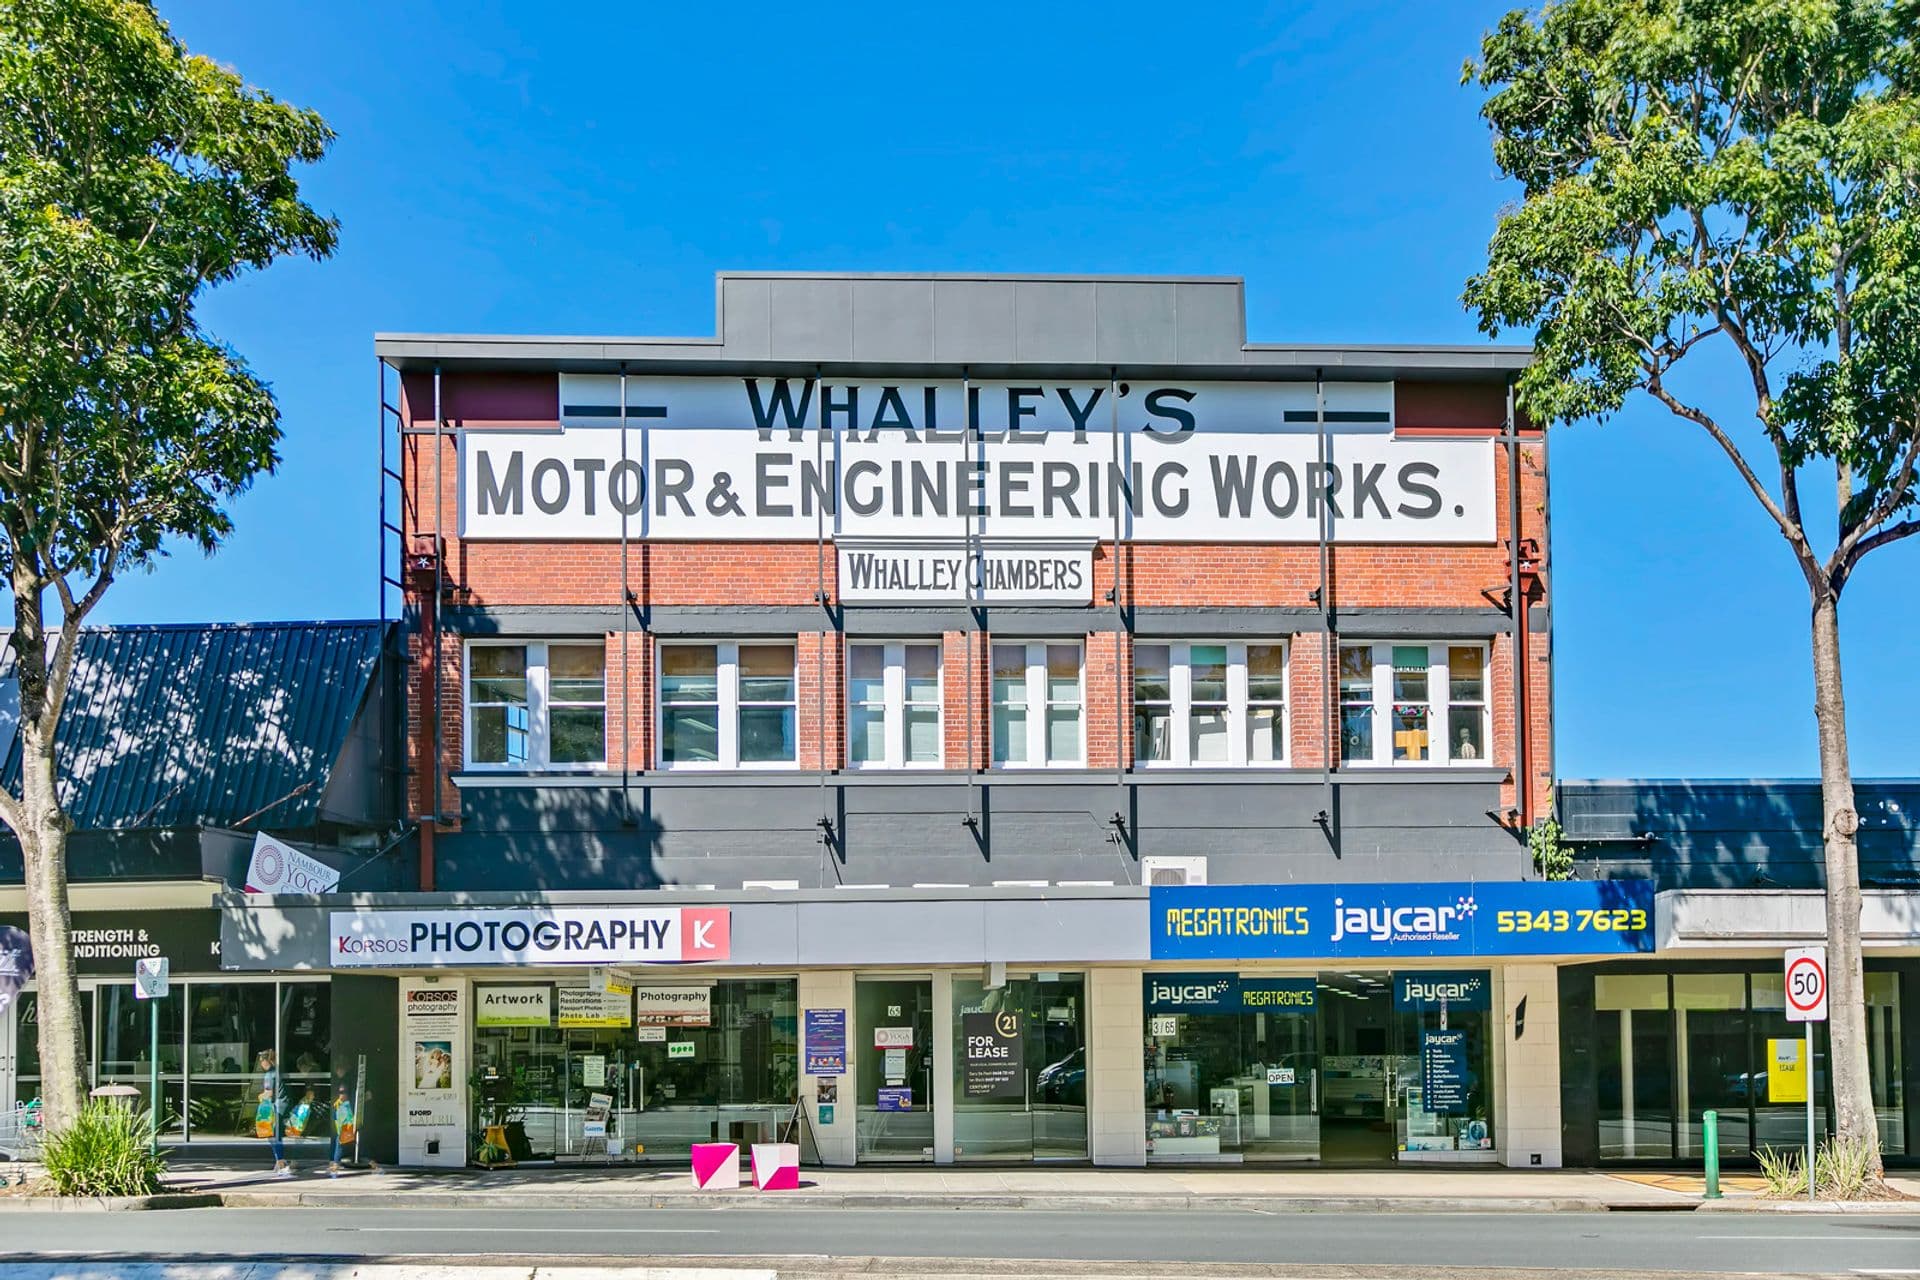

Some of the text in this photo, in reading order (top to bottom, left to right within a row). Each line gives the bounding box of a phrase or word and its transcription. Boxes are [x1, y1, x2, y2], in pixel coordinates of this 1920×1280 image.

[742, 378, 1198, 444] WHALLEY'S
[476, 450, 1465, 520] MOTOR & ENGINEERING WORKS.
[847, 553, 1083, 591] WHALLEY CHAMBERS
[287, 851, 333, 881] NAMBOUR
[1166, 897, 1648, 943] MEGATRONICS jaycar 5343 7623
[71, 929, 149, 944] TRENGTH &
[338, 919, 672, 954] KORSOS PHOTOGRAPHY
[693, 919, 716, 950] K
[1392, 931, 1461, 942] Authorised Reseller
[74, 944, 161, 958] NDITIONING
[1403, 979, 1470, 1002] jaycar
[1794, 972, 1818, 995] 50
[407, 990, 458, 1002] KORSOS
[485, 993, 544, 1005] Artwork
[640, 992, 707, 1003] Photography
[1150, 981, 1217, 1005] jaycar
[1243, 991, 1314, 1006] MEGATRONICS
[407, 1003, 458, 1012] photography
[1002, 1015, 1017, 1030] 21
[968, 1036, 994, 1047] FOR
[1424, 1033, 1457, 1045] jaycar
[670, 1046, 693, 1054] open
[968, 1047, 1009, 1059] LEASE
[1268, 1074, 1294, 1082] OPEN
